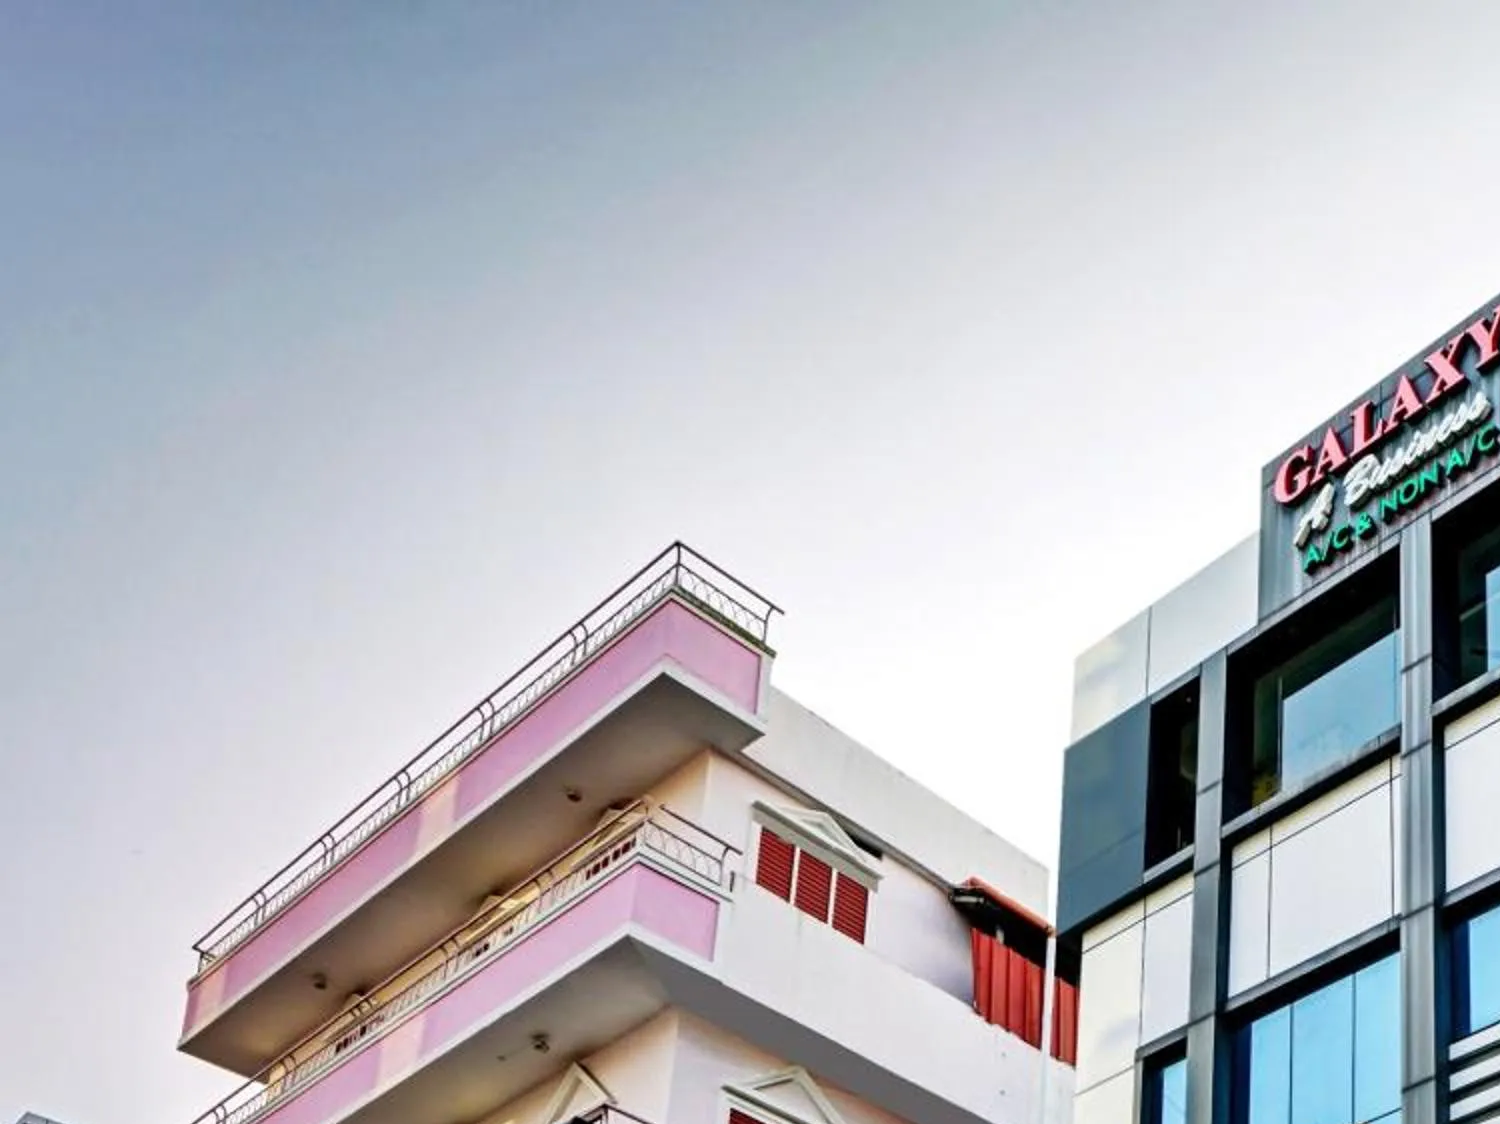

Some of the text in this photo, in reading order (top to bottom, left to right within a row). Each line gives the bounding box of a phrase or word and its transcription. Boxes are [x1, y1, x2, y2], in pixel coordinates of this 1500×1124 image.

[1303, 522, 1351, 574] A/C
[1378, 462, 1441, 523] NON
[1444, 422, 1498, 477] A/C
